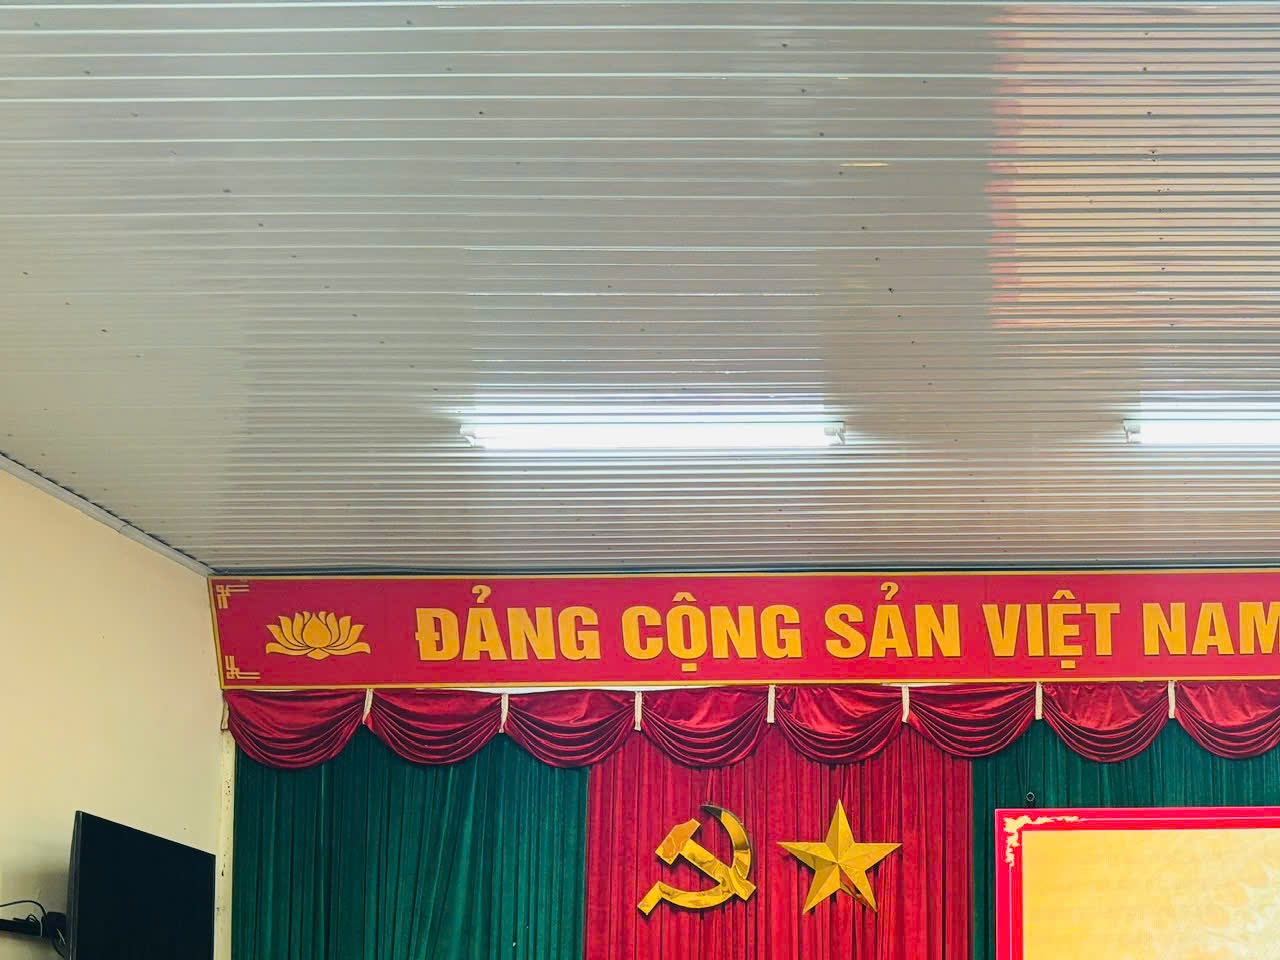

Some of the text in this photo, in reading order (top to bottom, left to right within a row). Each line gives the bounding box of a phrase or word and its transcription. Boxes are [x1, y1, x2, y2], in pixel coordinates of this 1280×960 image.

[415, 584, 600, 662] ĐẢNG
[621, 591, 802, 672] CỘNG
[824, 581, 961, 658] SẢN
[982, 589, 1121, 669] VIỆT
